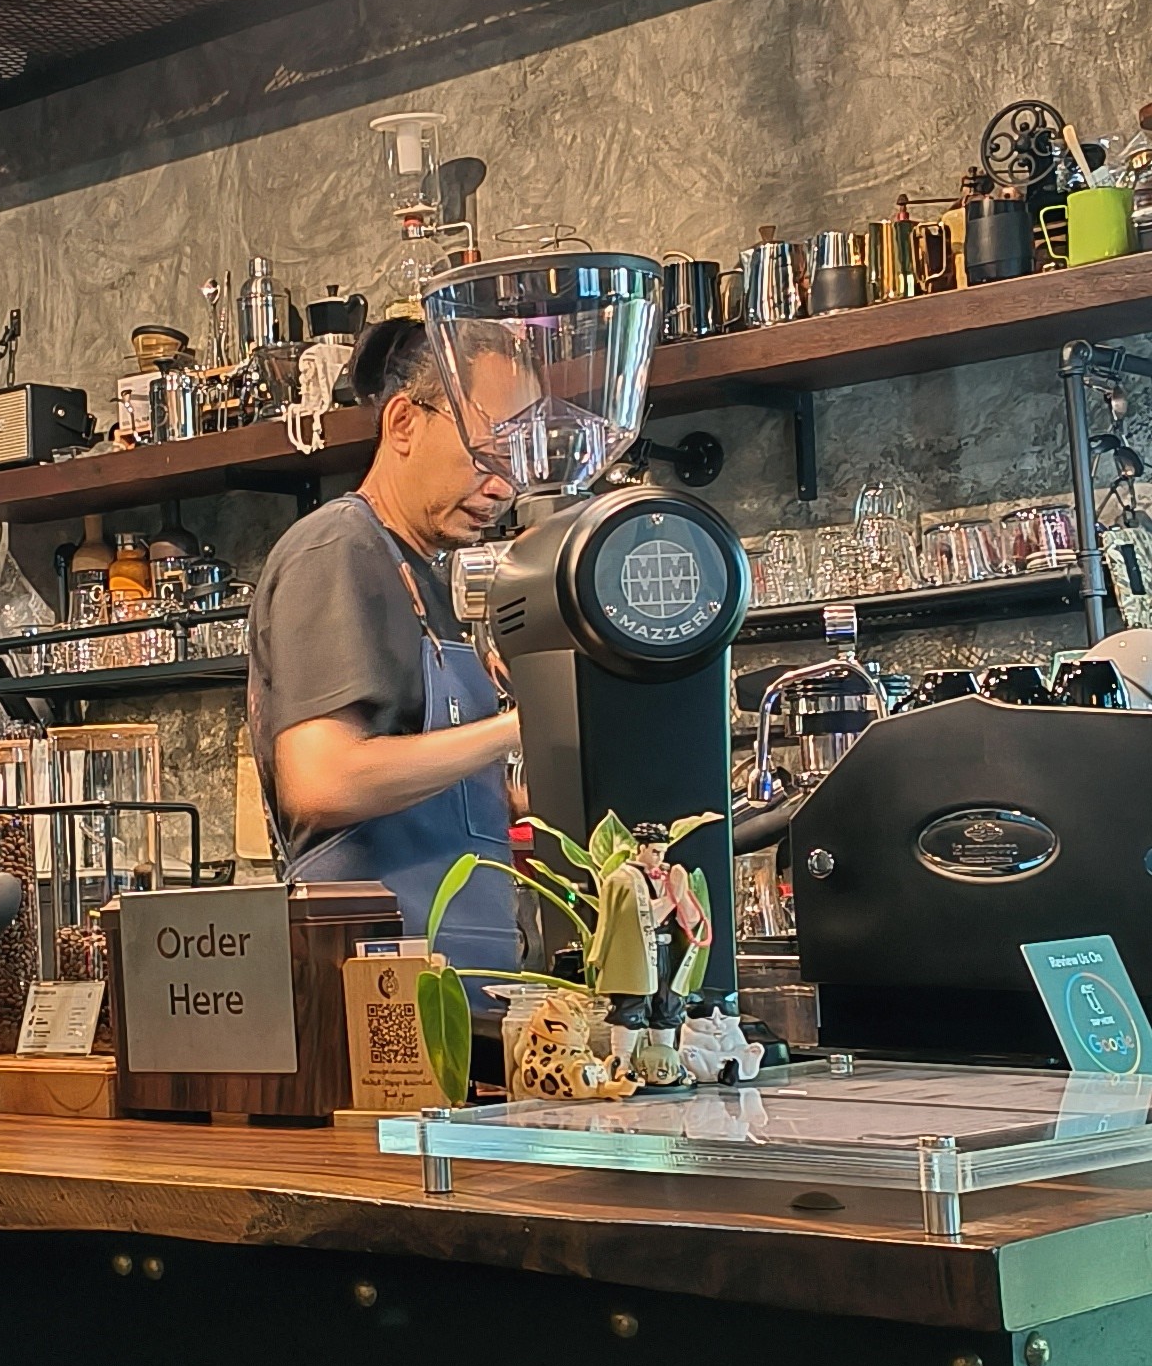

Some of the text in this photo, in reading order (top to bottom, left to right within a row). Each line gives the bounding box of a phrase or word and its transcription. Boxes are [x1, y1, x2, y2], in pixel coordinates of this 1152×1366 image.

[619, 610, 709, 640] MAZZER
[156, 923, 251, 959] Order
[1049, 951, 1104, 967] Review Us On
[169, 983, 244, 1015] Here
[1088, 1030, 1135, 1055] Google
